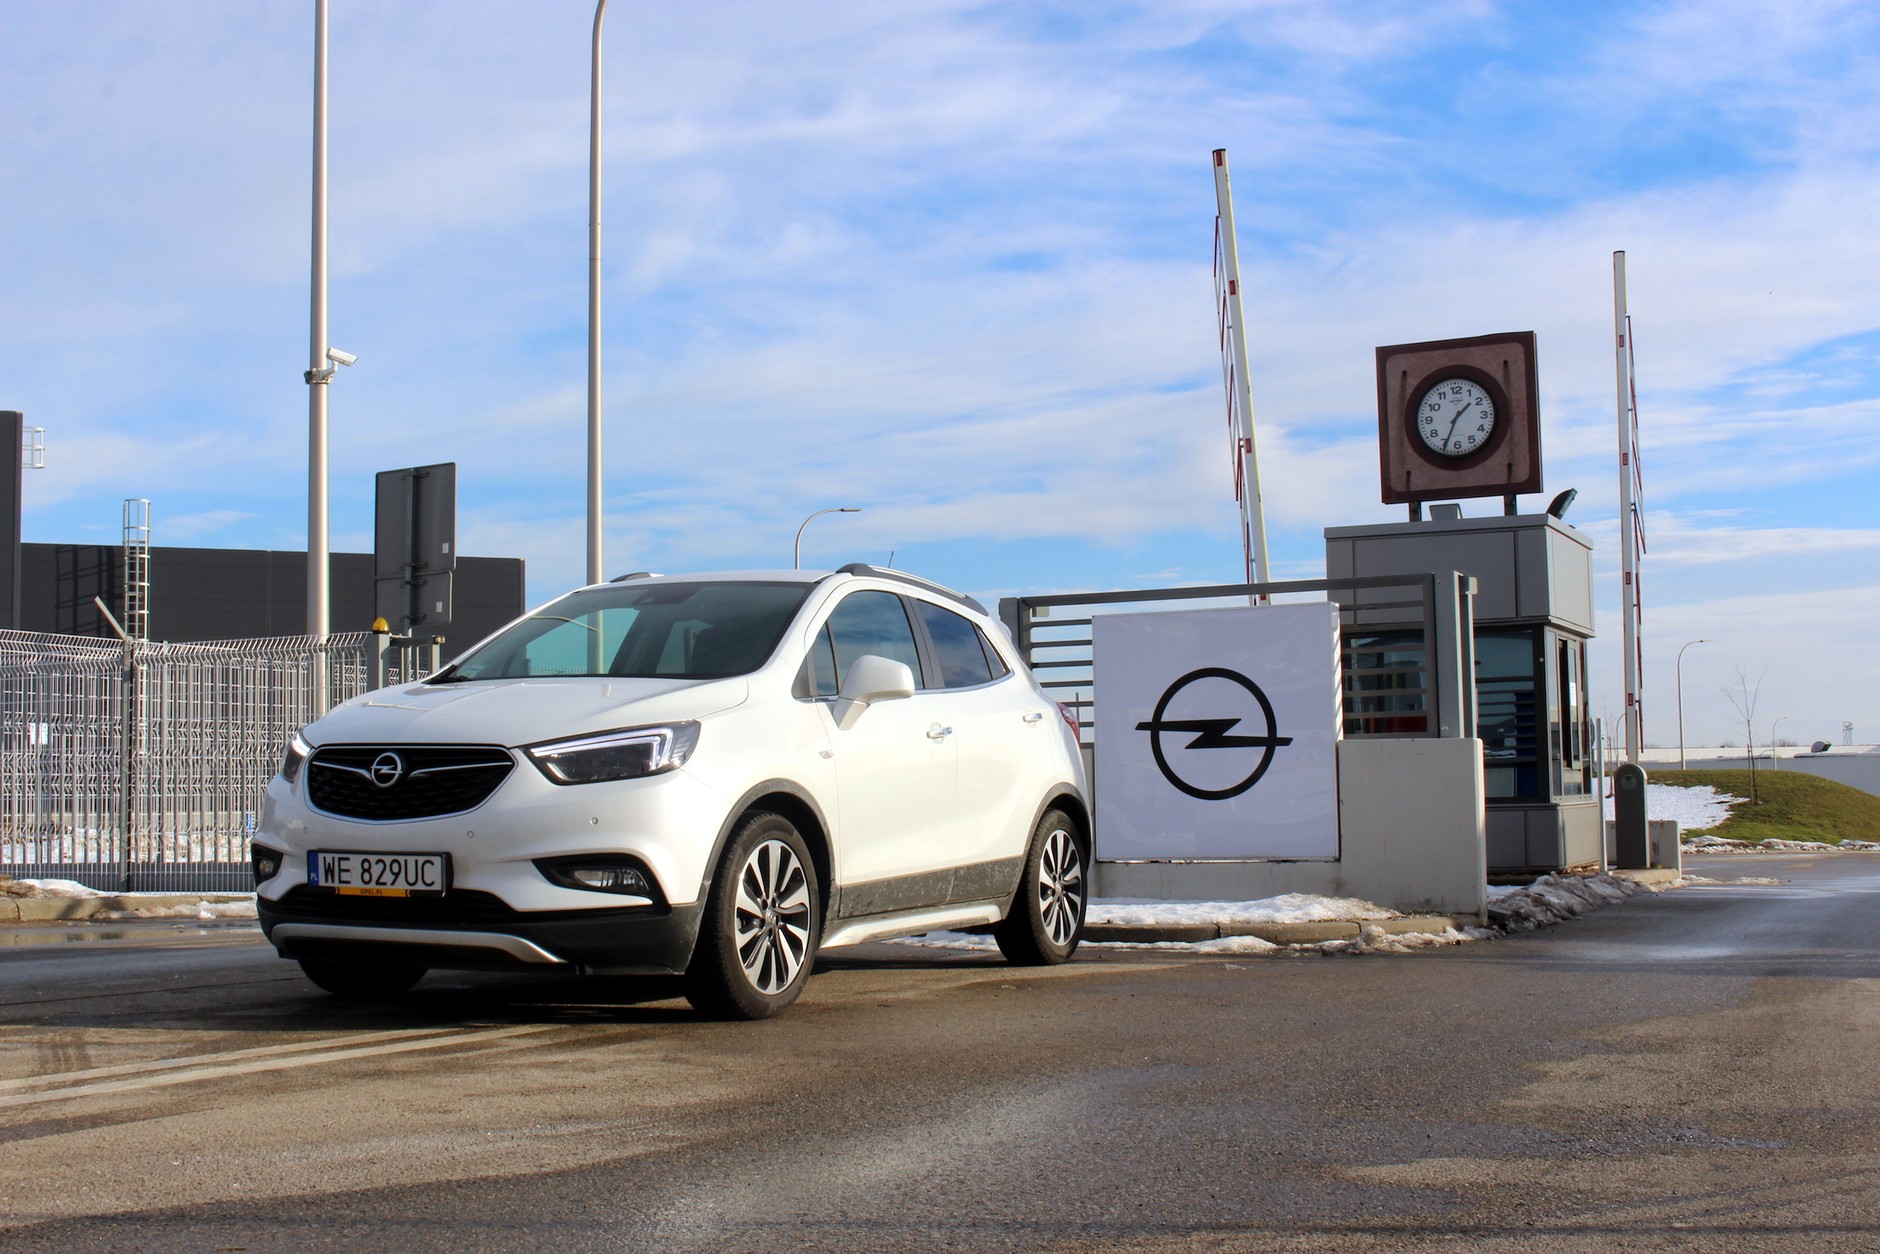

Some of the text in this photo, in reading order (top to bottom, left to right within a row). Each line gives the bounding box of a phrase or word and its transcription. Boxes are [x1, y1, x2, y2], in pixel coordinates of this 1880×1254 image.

[1450, 386, 1462, 394] 12
[1467, 389, 1471, 397] 1
[1437, 392, 1446, 400] 11
[1475, 397, 1483, 405] 2
[1428, 403, 1440, 411] 10
[1480, 411, 1488, 419] 3
[1425, 416, 1433, 424] 9
[1477, 424, 1485, 432] 4
[1430, 429, 1438, 437] 8
[1468, 435, 1476, 443] 5
[1454, 441, 1461, 449] 6
[323, 856, 435, 887] WE 829UC
